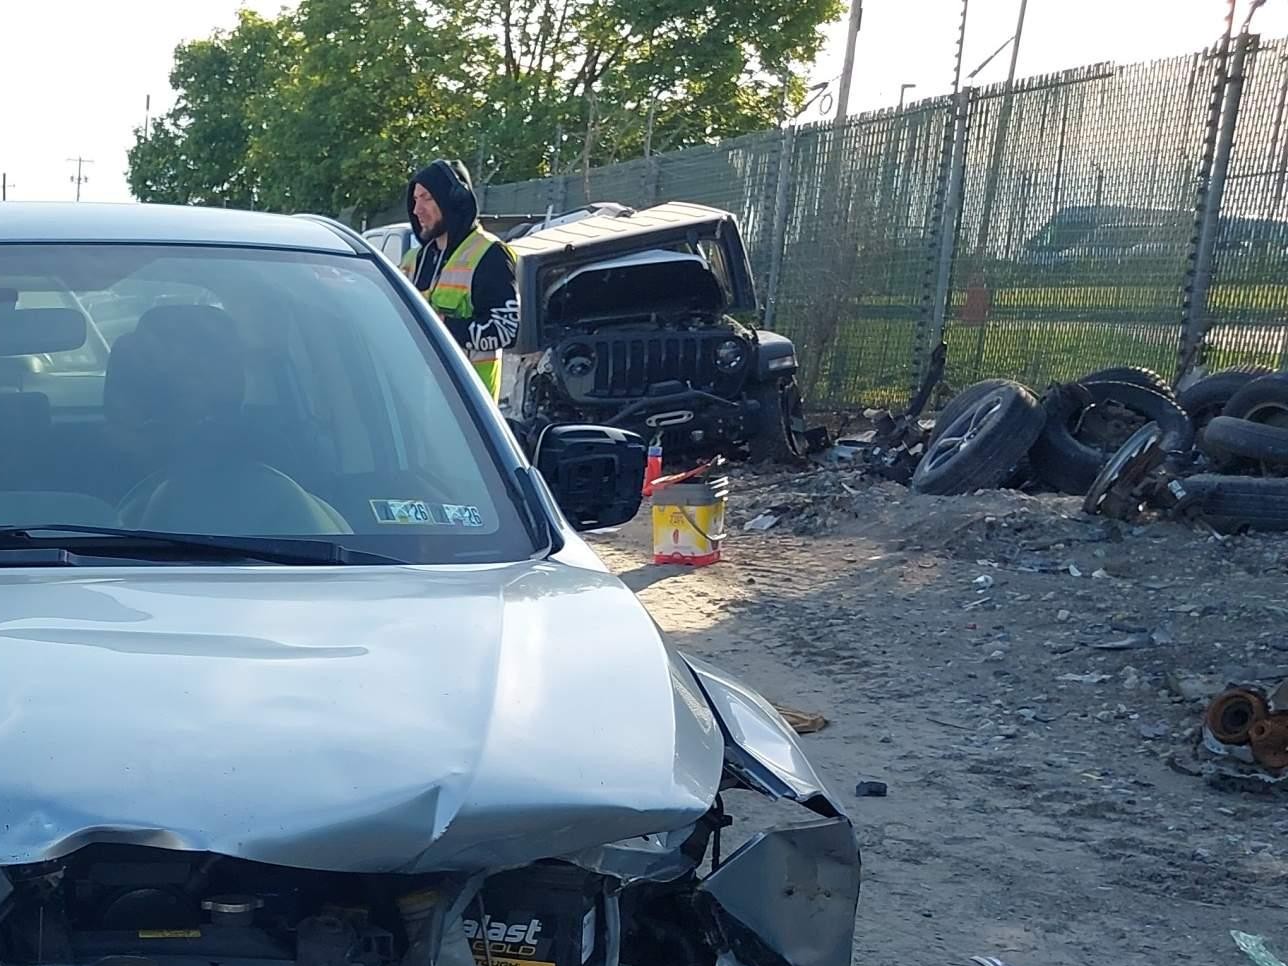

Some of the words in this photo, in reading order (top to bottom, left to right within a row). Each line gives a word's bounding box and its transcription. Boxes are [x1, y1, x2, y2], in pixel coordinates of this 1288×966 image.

[466, 320, 498, 351] Von
[410, 503, 428, 521] 26
[464, 507, 482, 525] 26
[473, 940, 536, 956] GOLD
